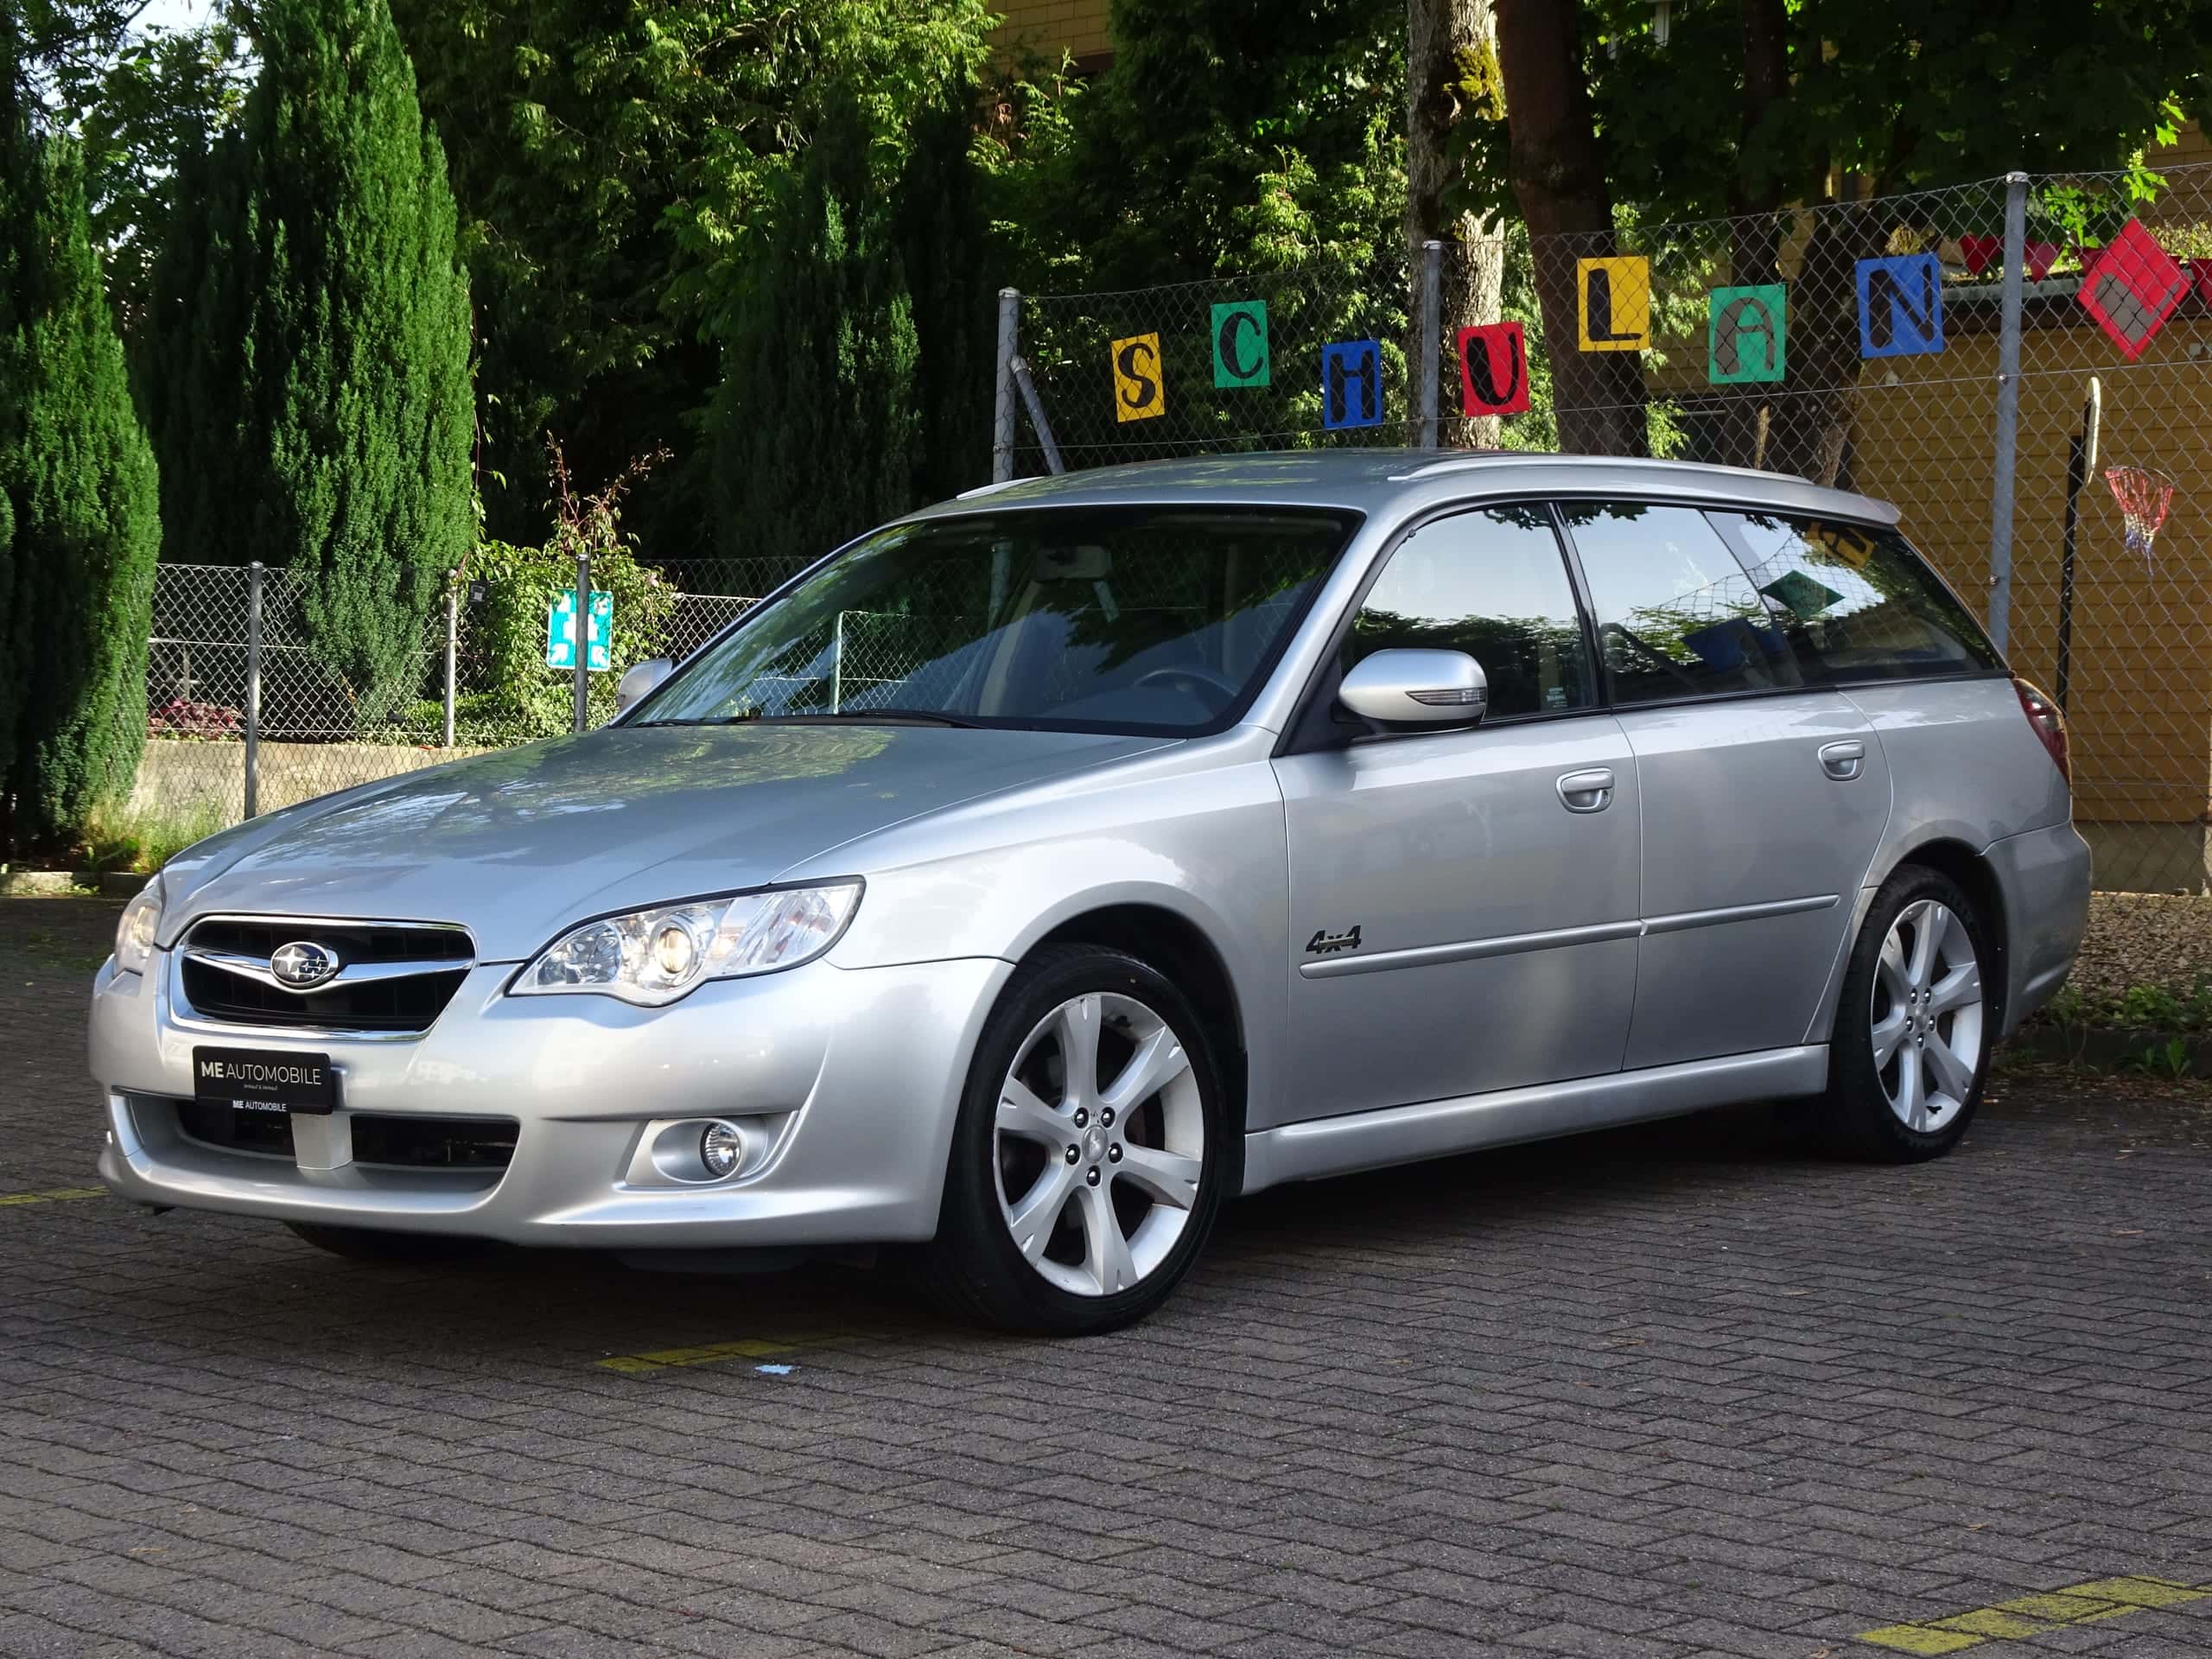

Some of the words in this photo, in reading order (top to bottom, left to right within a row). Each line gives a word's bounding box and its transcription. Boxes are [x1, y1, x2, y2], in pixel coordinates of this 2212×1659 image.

[1117, 343, 1155, 408] S
[1218, 311, 1263, 379] C
[1466, 331, 1520, 406] U
[1587, 269, 1642, 341] L
[1714, 296, 1776, 376] A
[1868, 263, 1936, 347] N
[200, 1061, 224, 1078] ME
[226, 1064, 322, 1085] AUTOMOBILE
[232, 1099, 245, 1109] ME
[245, 1101, 287, 1112] AUTOMOBILE
